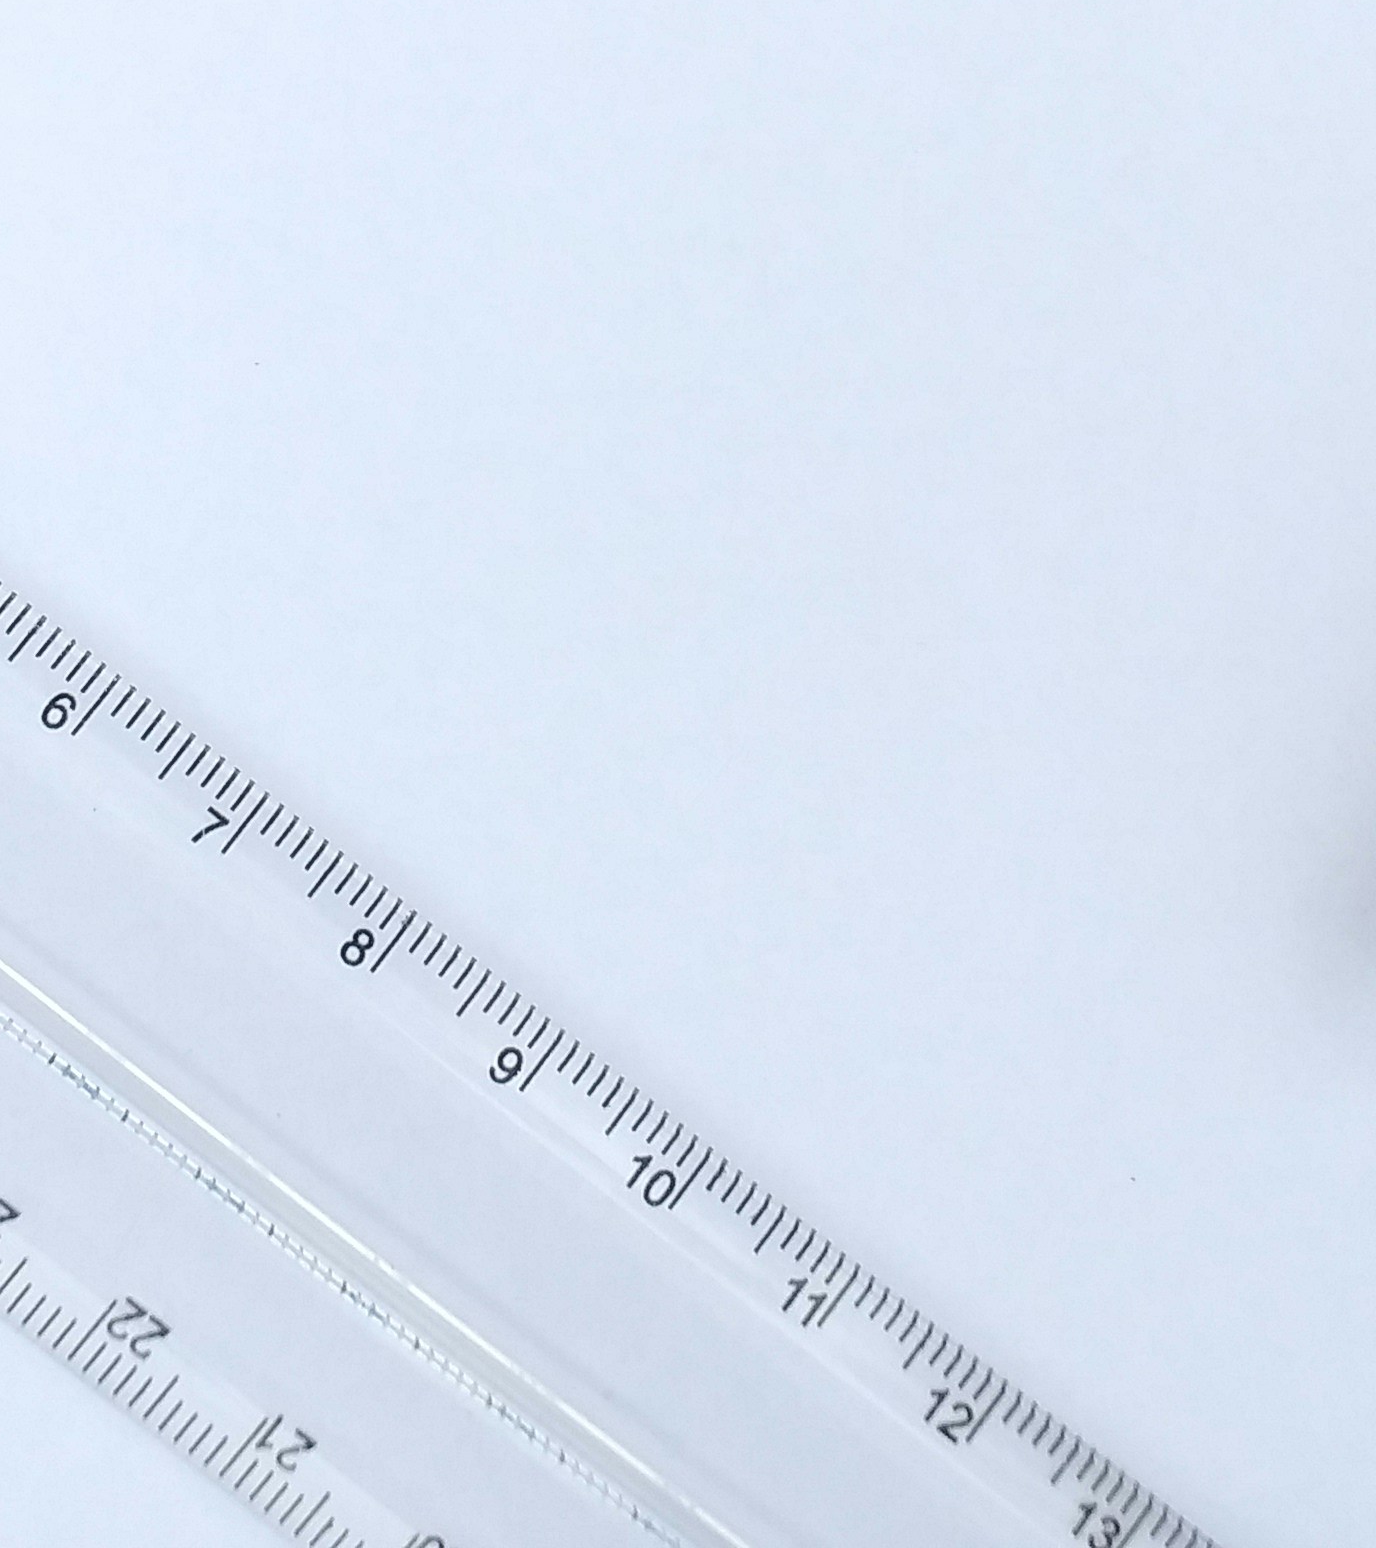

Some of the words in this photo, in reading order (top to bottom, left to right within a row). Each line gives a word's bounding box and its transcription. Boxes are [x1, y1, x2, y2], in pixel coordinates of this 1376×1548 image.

[41, 692, 77, 730] 6
[192, 807, 230, 843] 7
[340, 929, 375, 966] 8
[489, 1047, 525, 1084] 9
[626, 1154, 676, 1209] 10
[782, 1276, 828, 1328] 11
[924, 1388, 975, 1445] 12
[1070, 1502, 1120, 1548] 13
[106, 1297, 171, 1360] 22
[254, 1414, 318, 1472] 21
